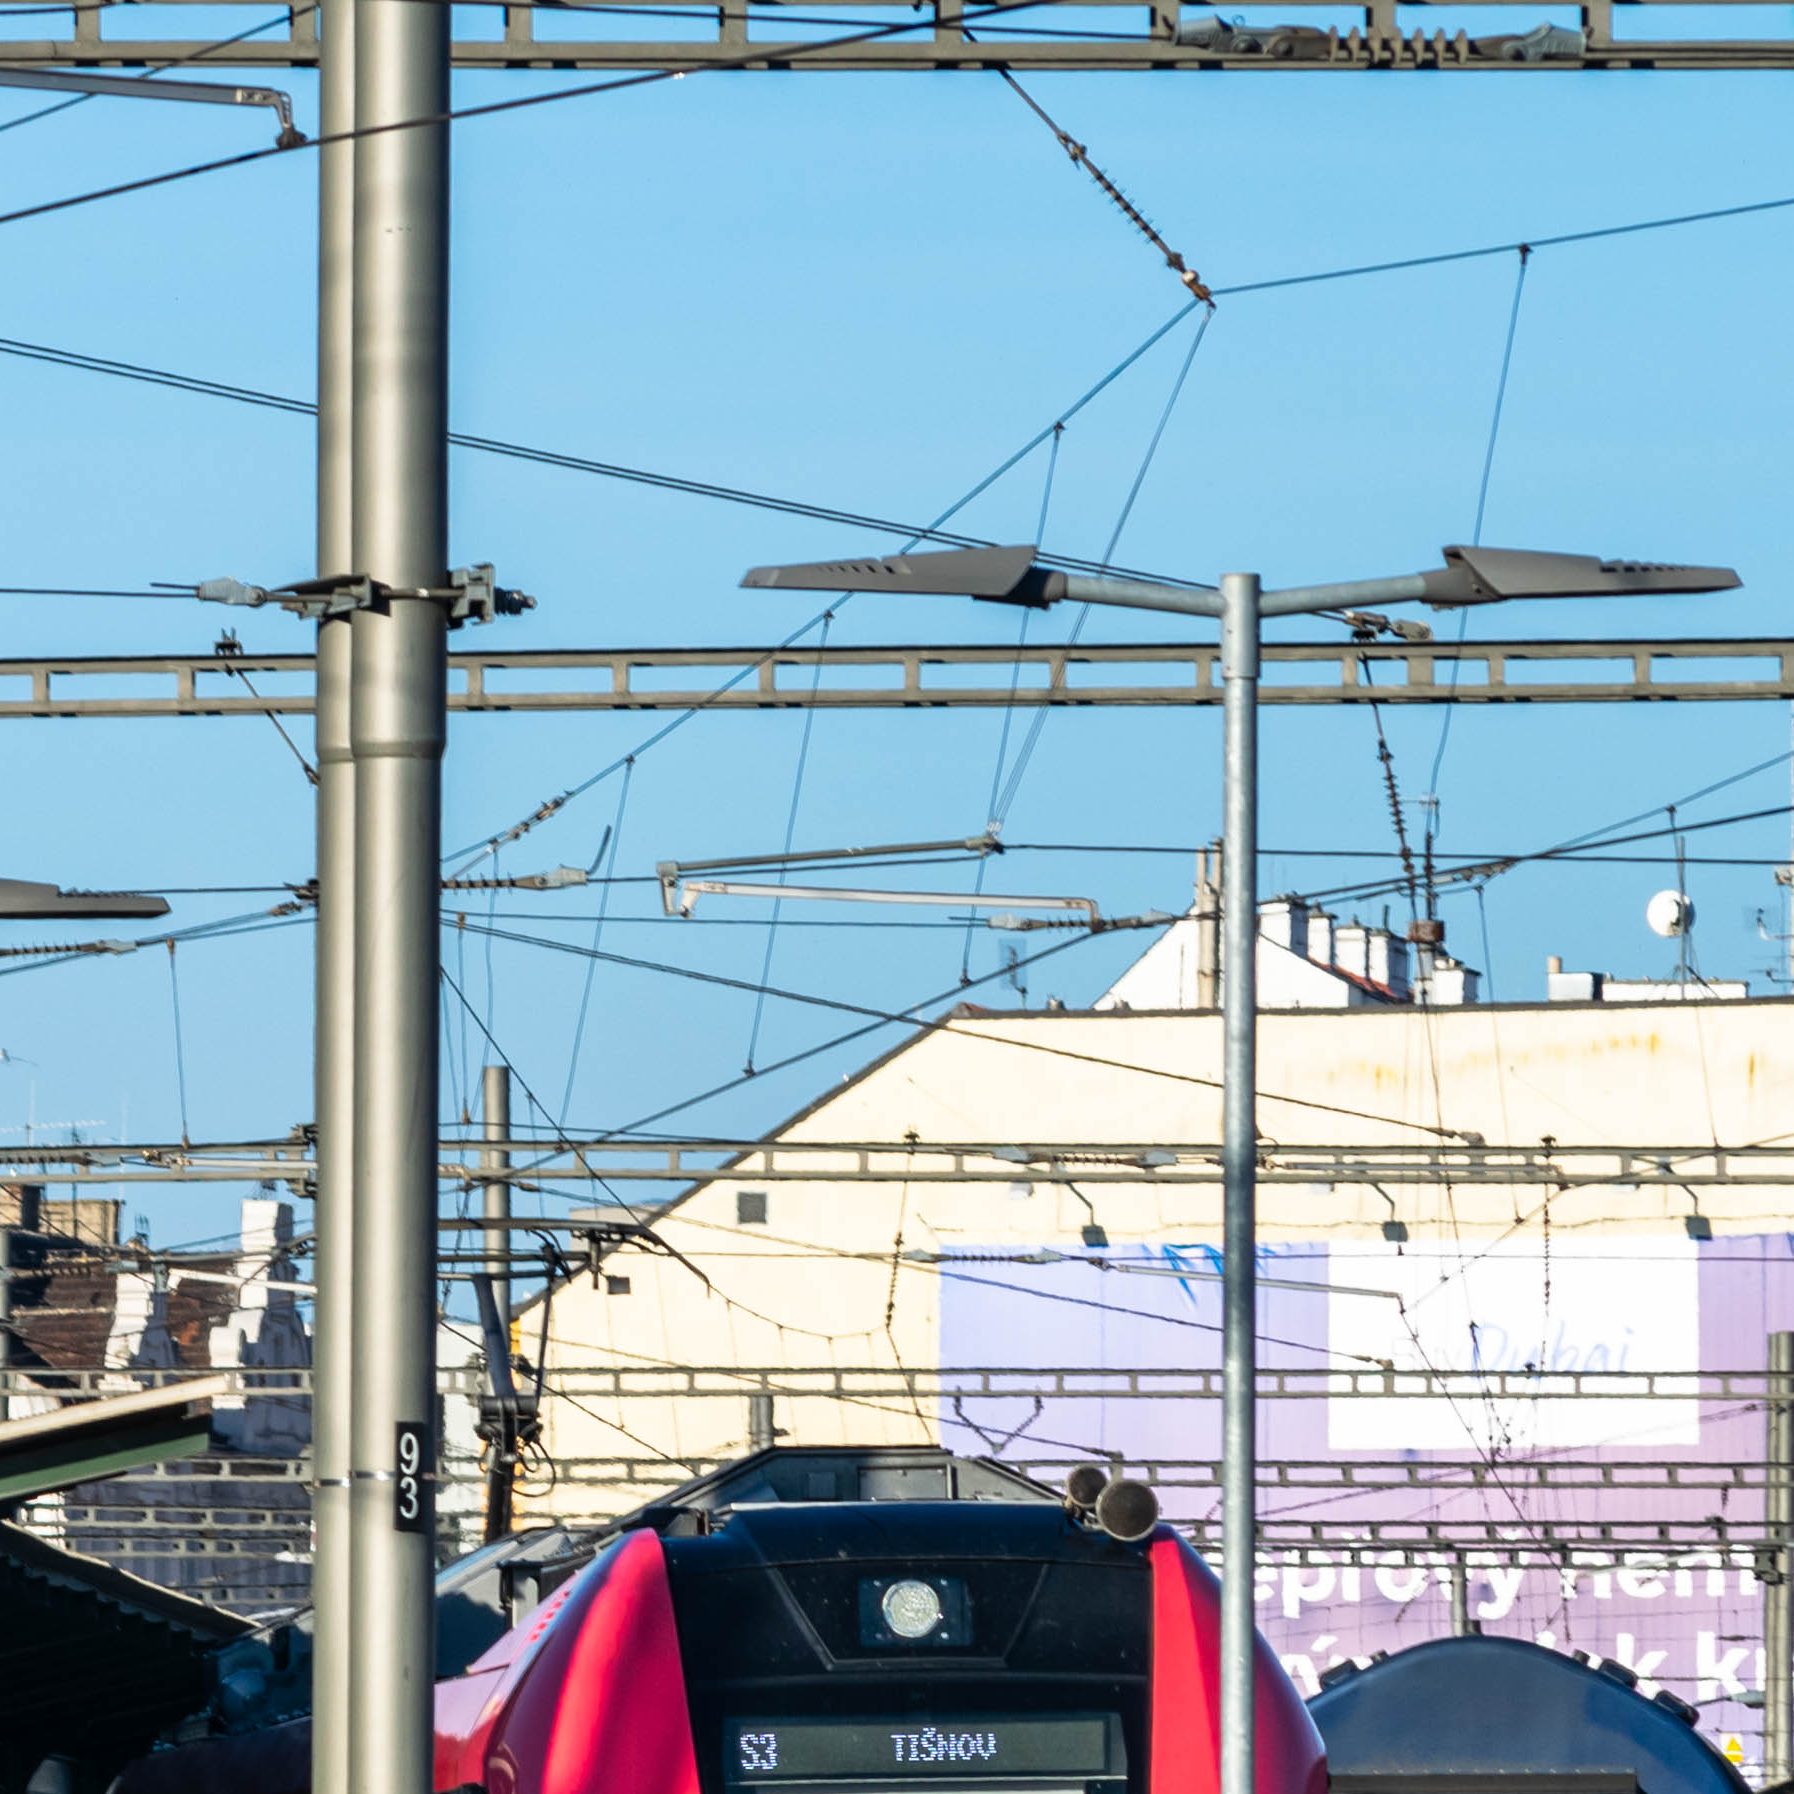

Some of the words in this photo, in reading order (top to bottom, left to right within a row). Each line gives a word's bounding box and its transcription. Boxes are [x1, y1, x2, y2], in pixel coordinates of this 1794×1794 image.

[400, 1431, 420, 1520] 93
[740, 1733, 778, 1770] S3
[890, 1726, 997, 1761] TIŠNOV
